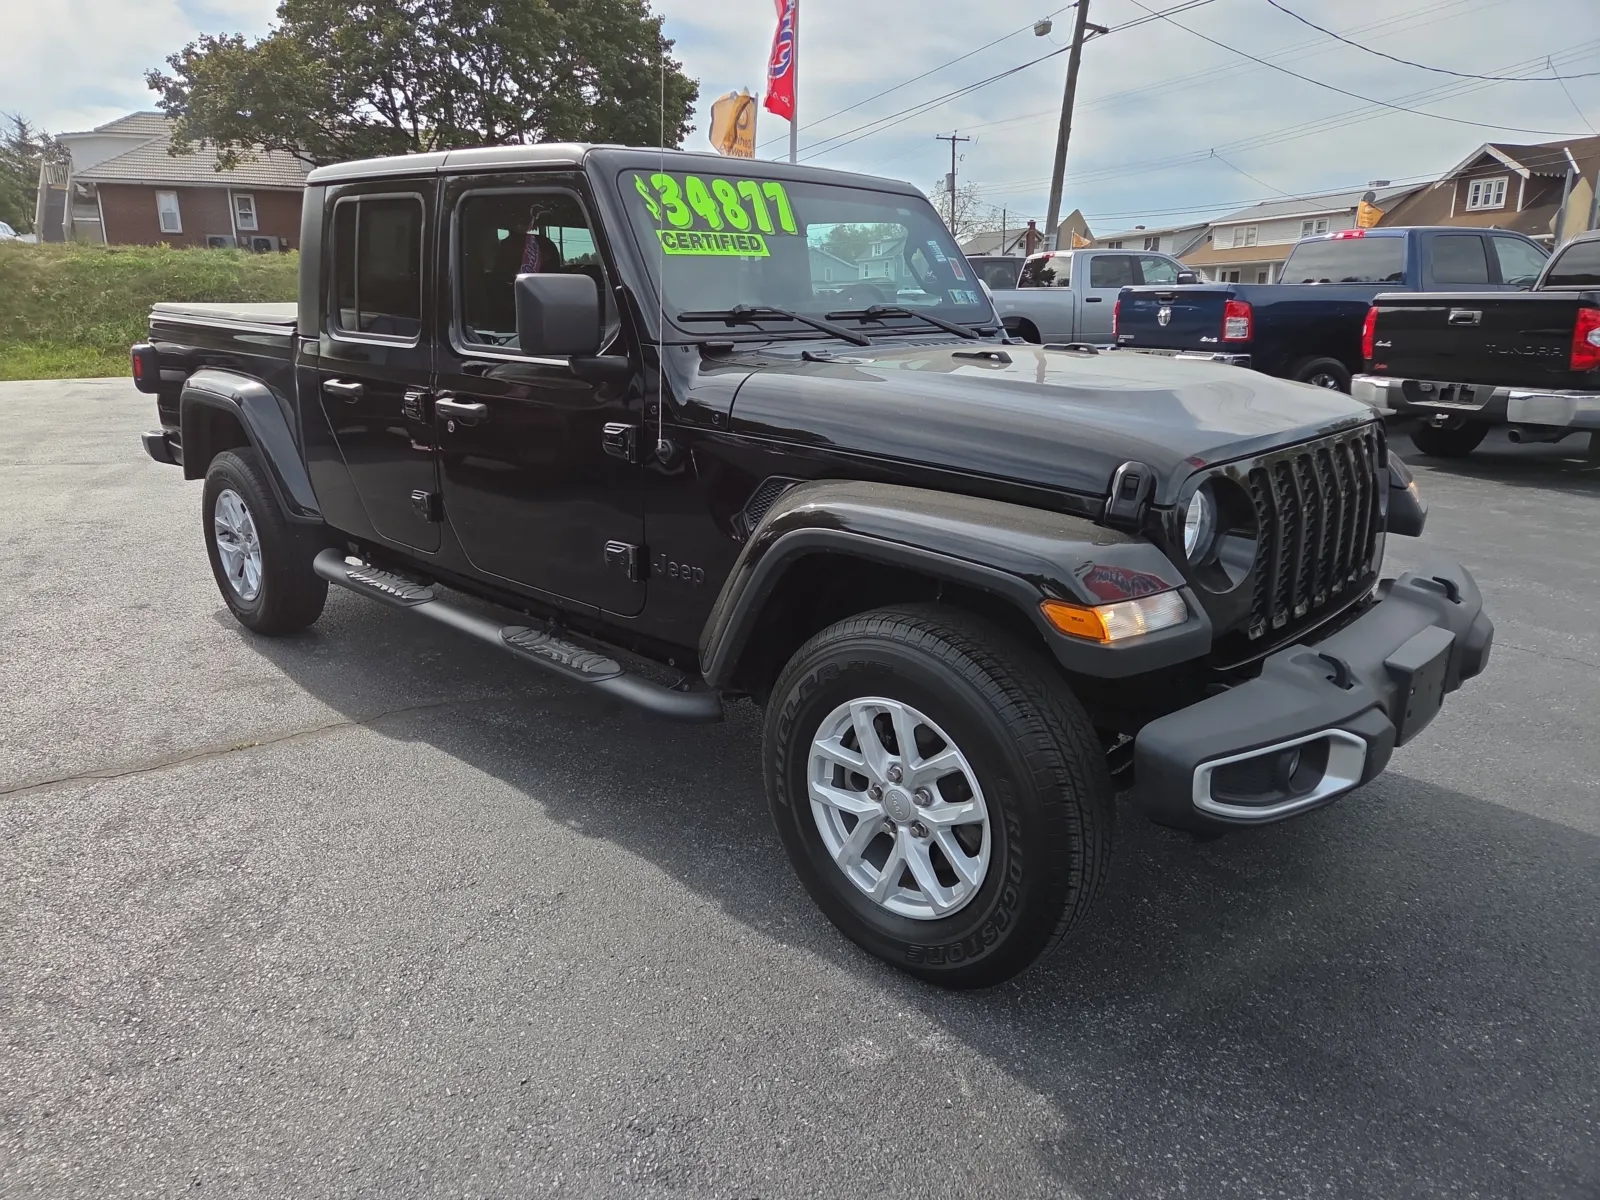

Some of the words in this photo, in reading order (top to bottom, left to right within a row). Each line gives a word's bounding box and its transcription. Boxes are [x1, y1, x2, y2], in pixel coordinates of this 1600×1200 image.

[634, 173, 798, 235] $34877
[661, 232, 763, 252] CERTIFIED
[1486, 344, 1563, 356] TUNDRA
[653, 553, 705, 587] Jeep
